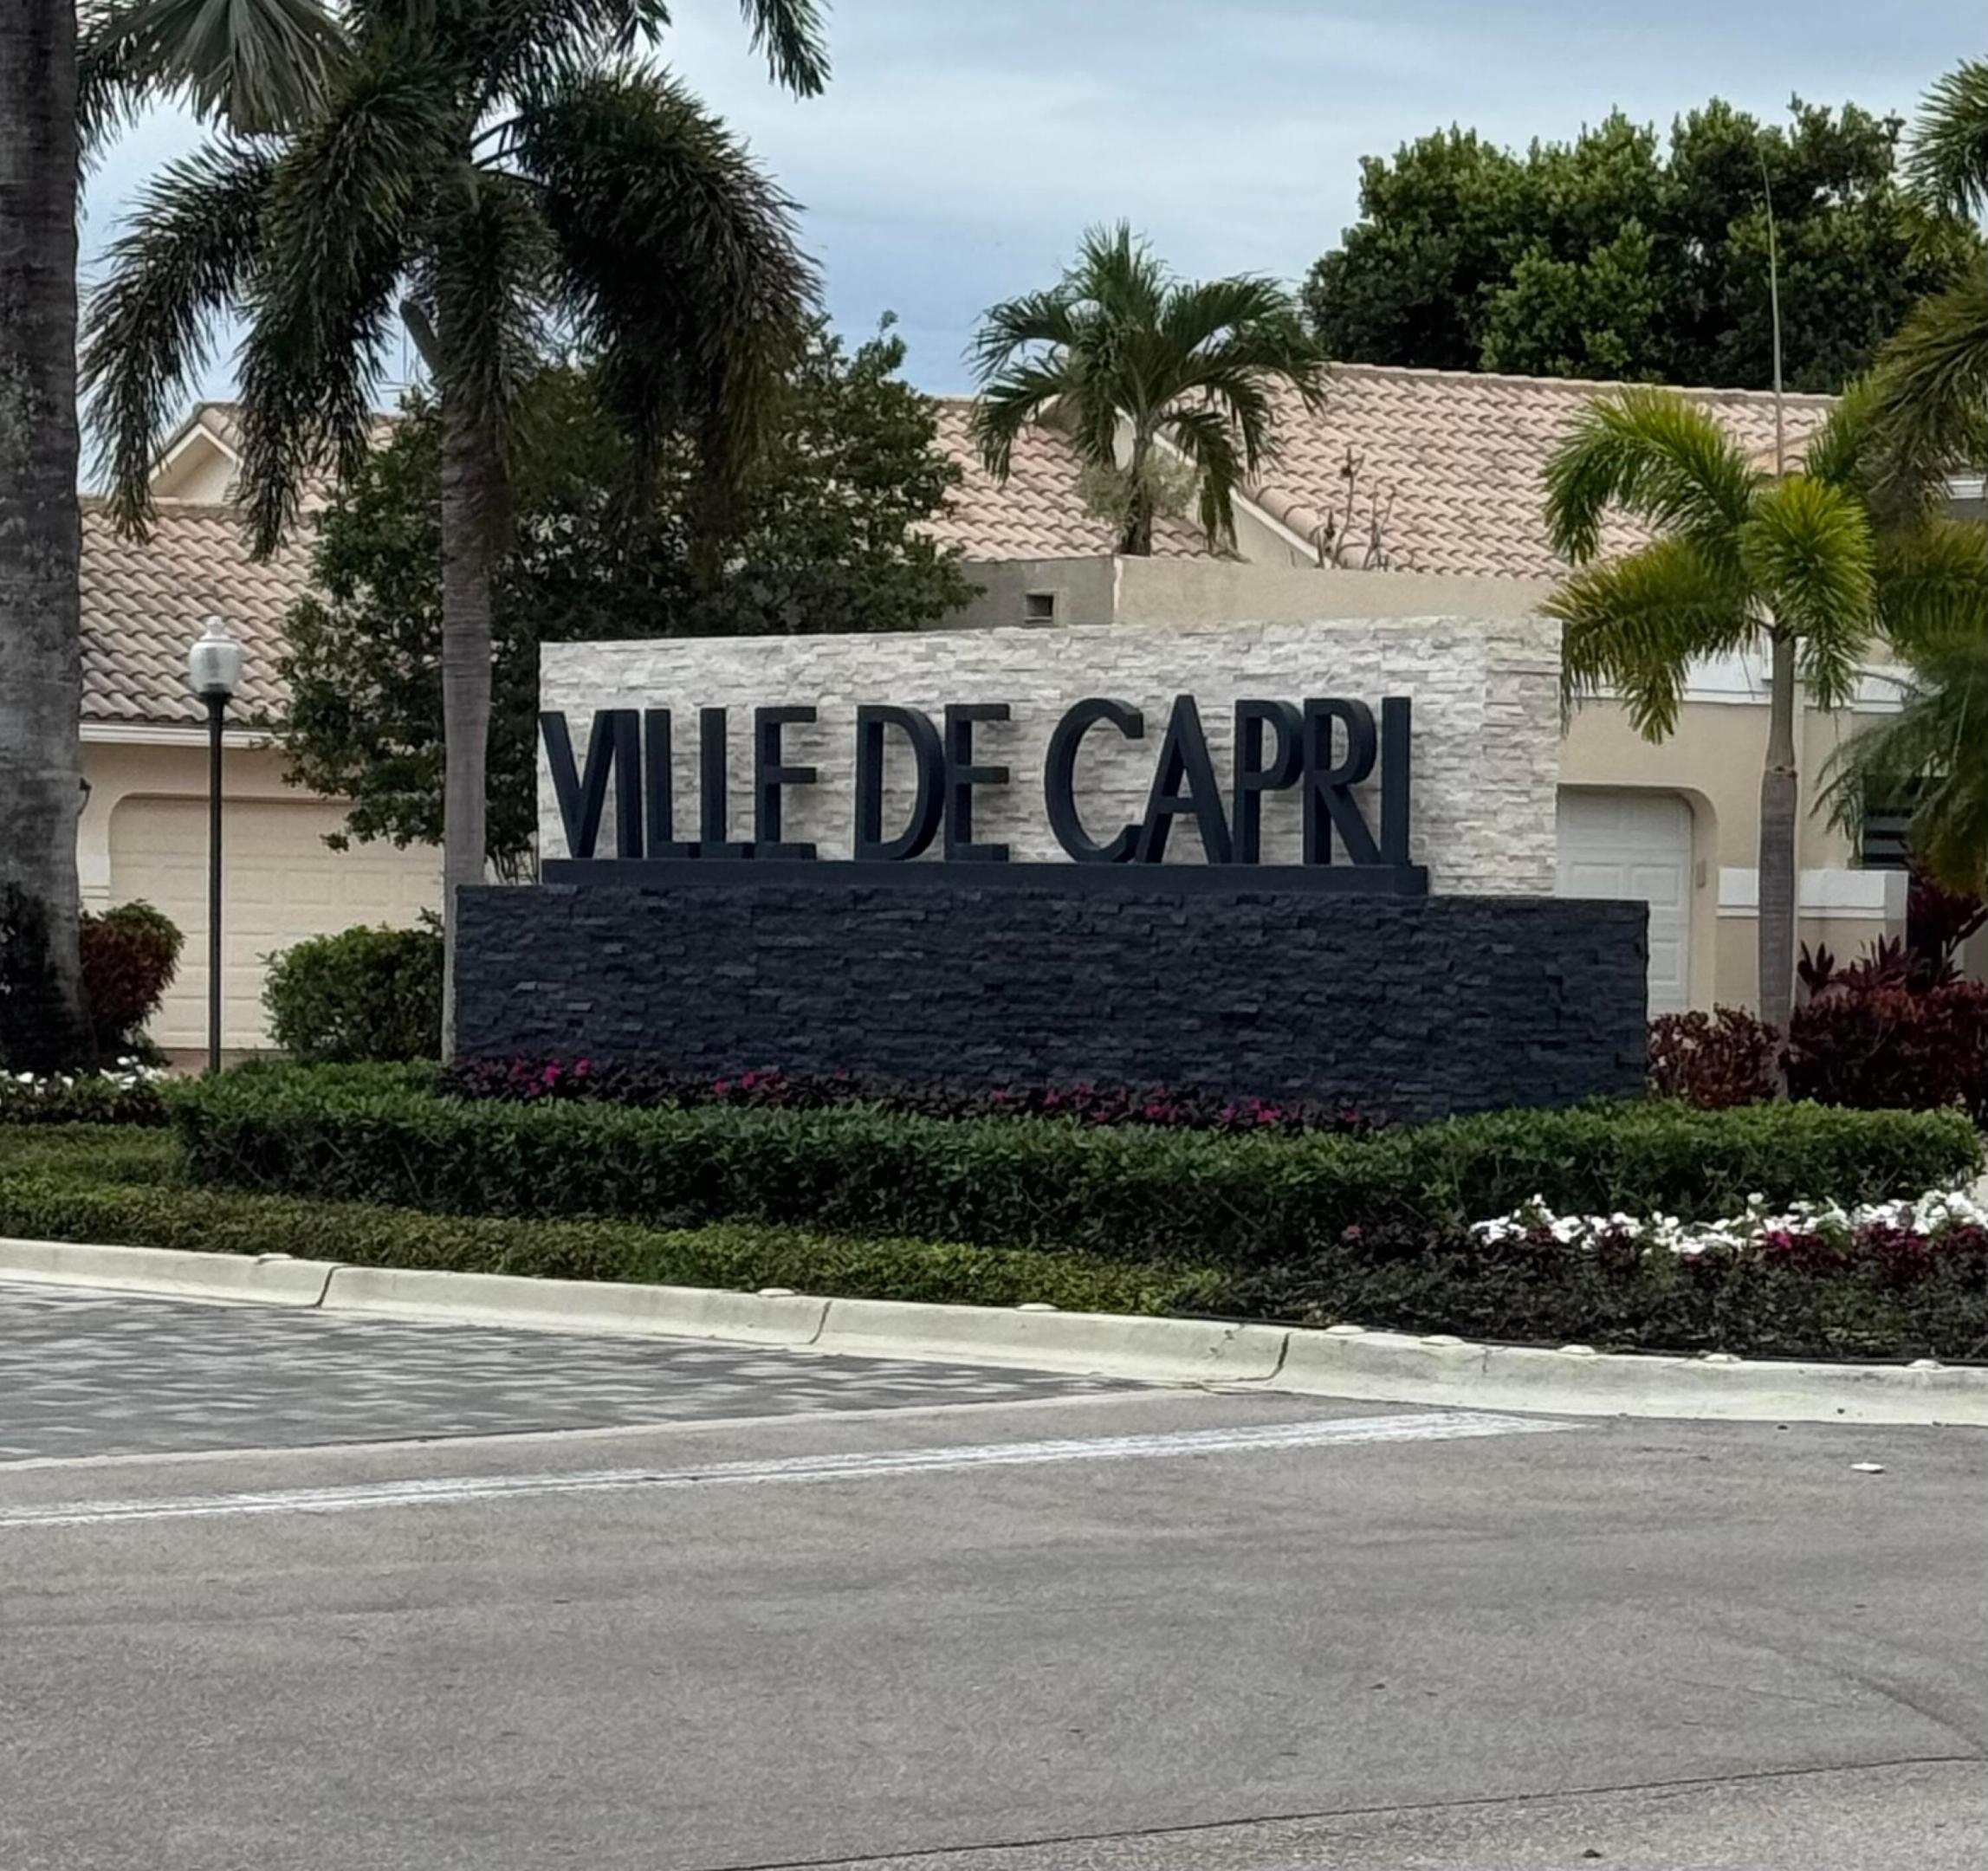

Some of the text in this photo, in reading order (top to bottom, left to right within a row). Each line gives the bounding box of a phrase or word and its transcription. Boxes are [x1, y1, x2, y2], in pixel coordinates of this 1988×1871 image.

[540, 694, 1411, 865] VILLE DE CAPRI
